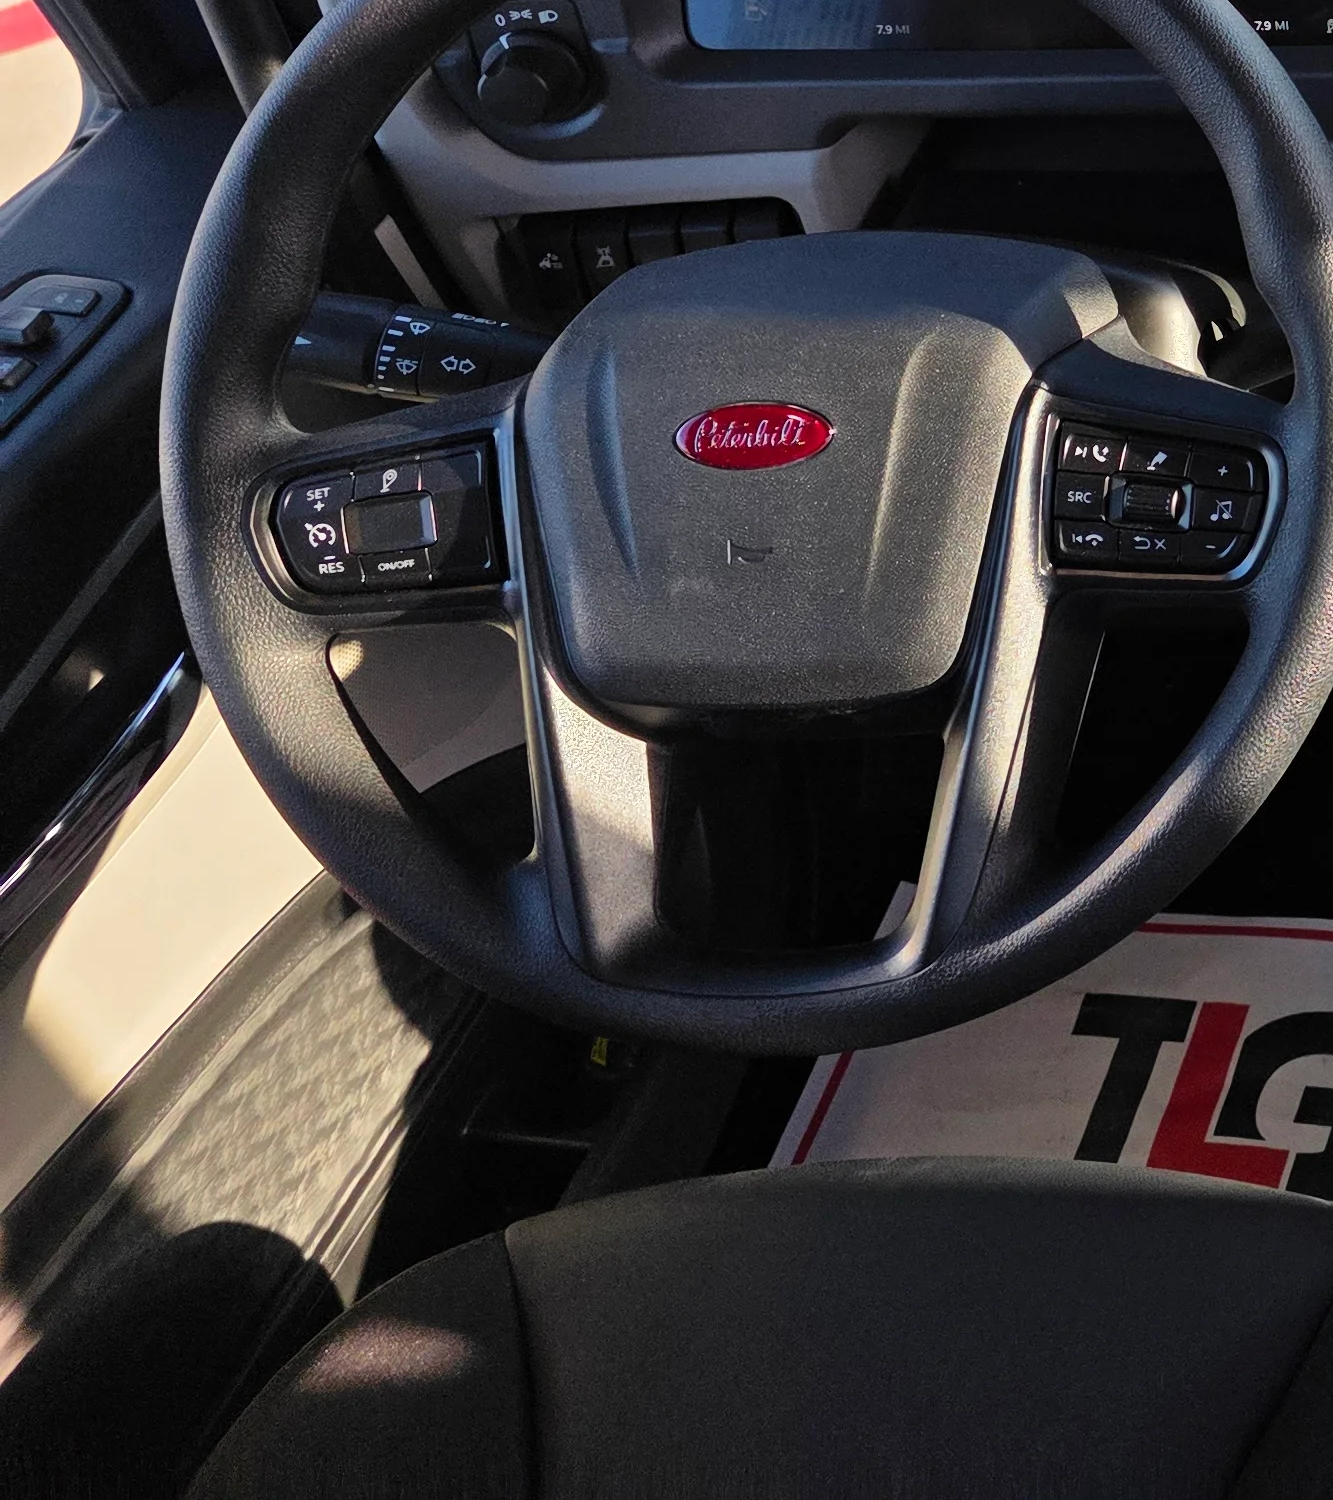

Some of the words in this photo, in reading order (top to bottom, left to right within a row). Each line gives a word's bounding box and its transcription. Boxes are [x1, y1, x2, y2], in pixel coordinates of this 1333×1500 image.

[876, 24, 893, 35] 7.9
[895, 25, 910, 35] MI
[1254, 20, 1272, 31] 7.9
[1274, 20, 1289, 31] MI
[694, 416, 810, 453] Peterbilt
[306, 486, 331, 501] SET
[1067, 491, 1092, 504] SRC
[318, 561, 345, 575] RES
[377, 558, 416, 572] ON/OFF
